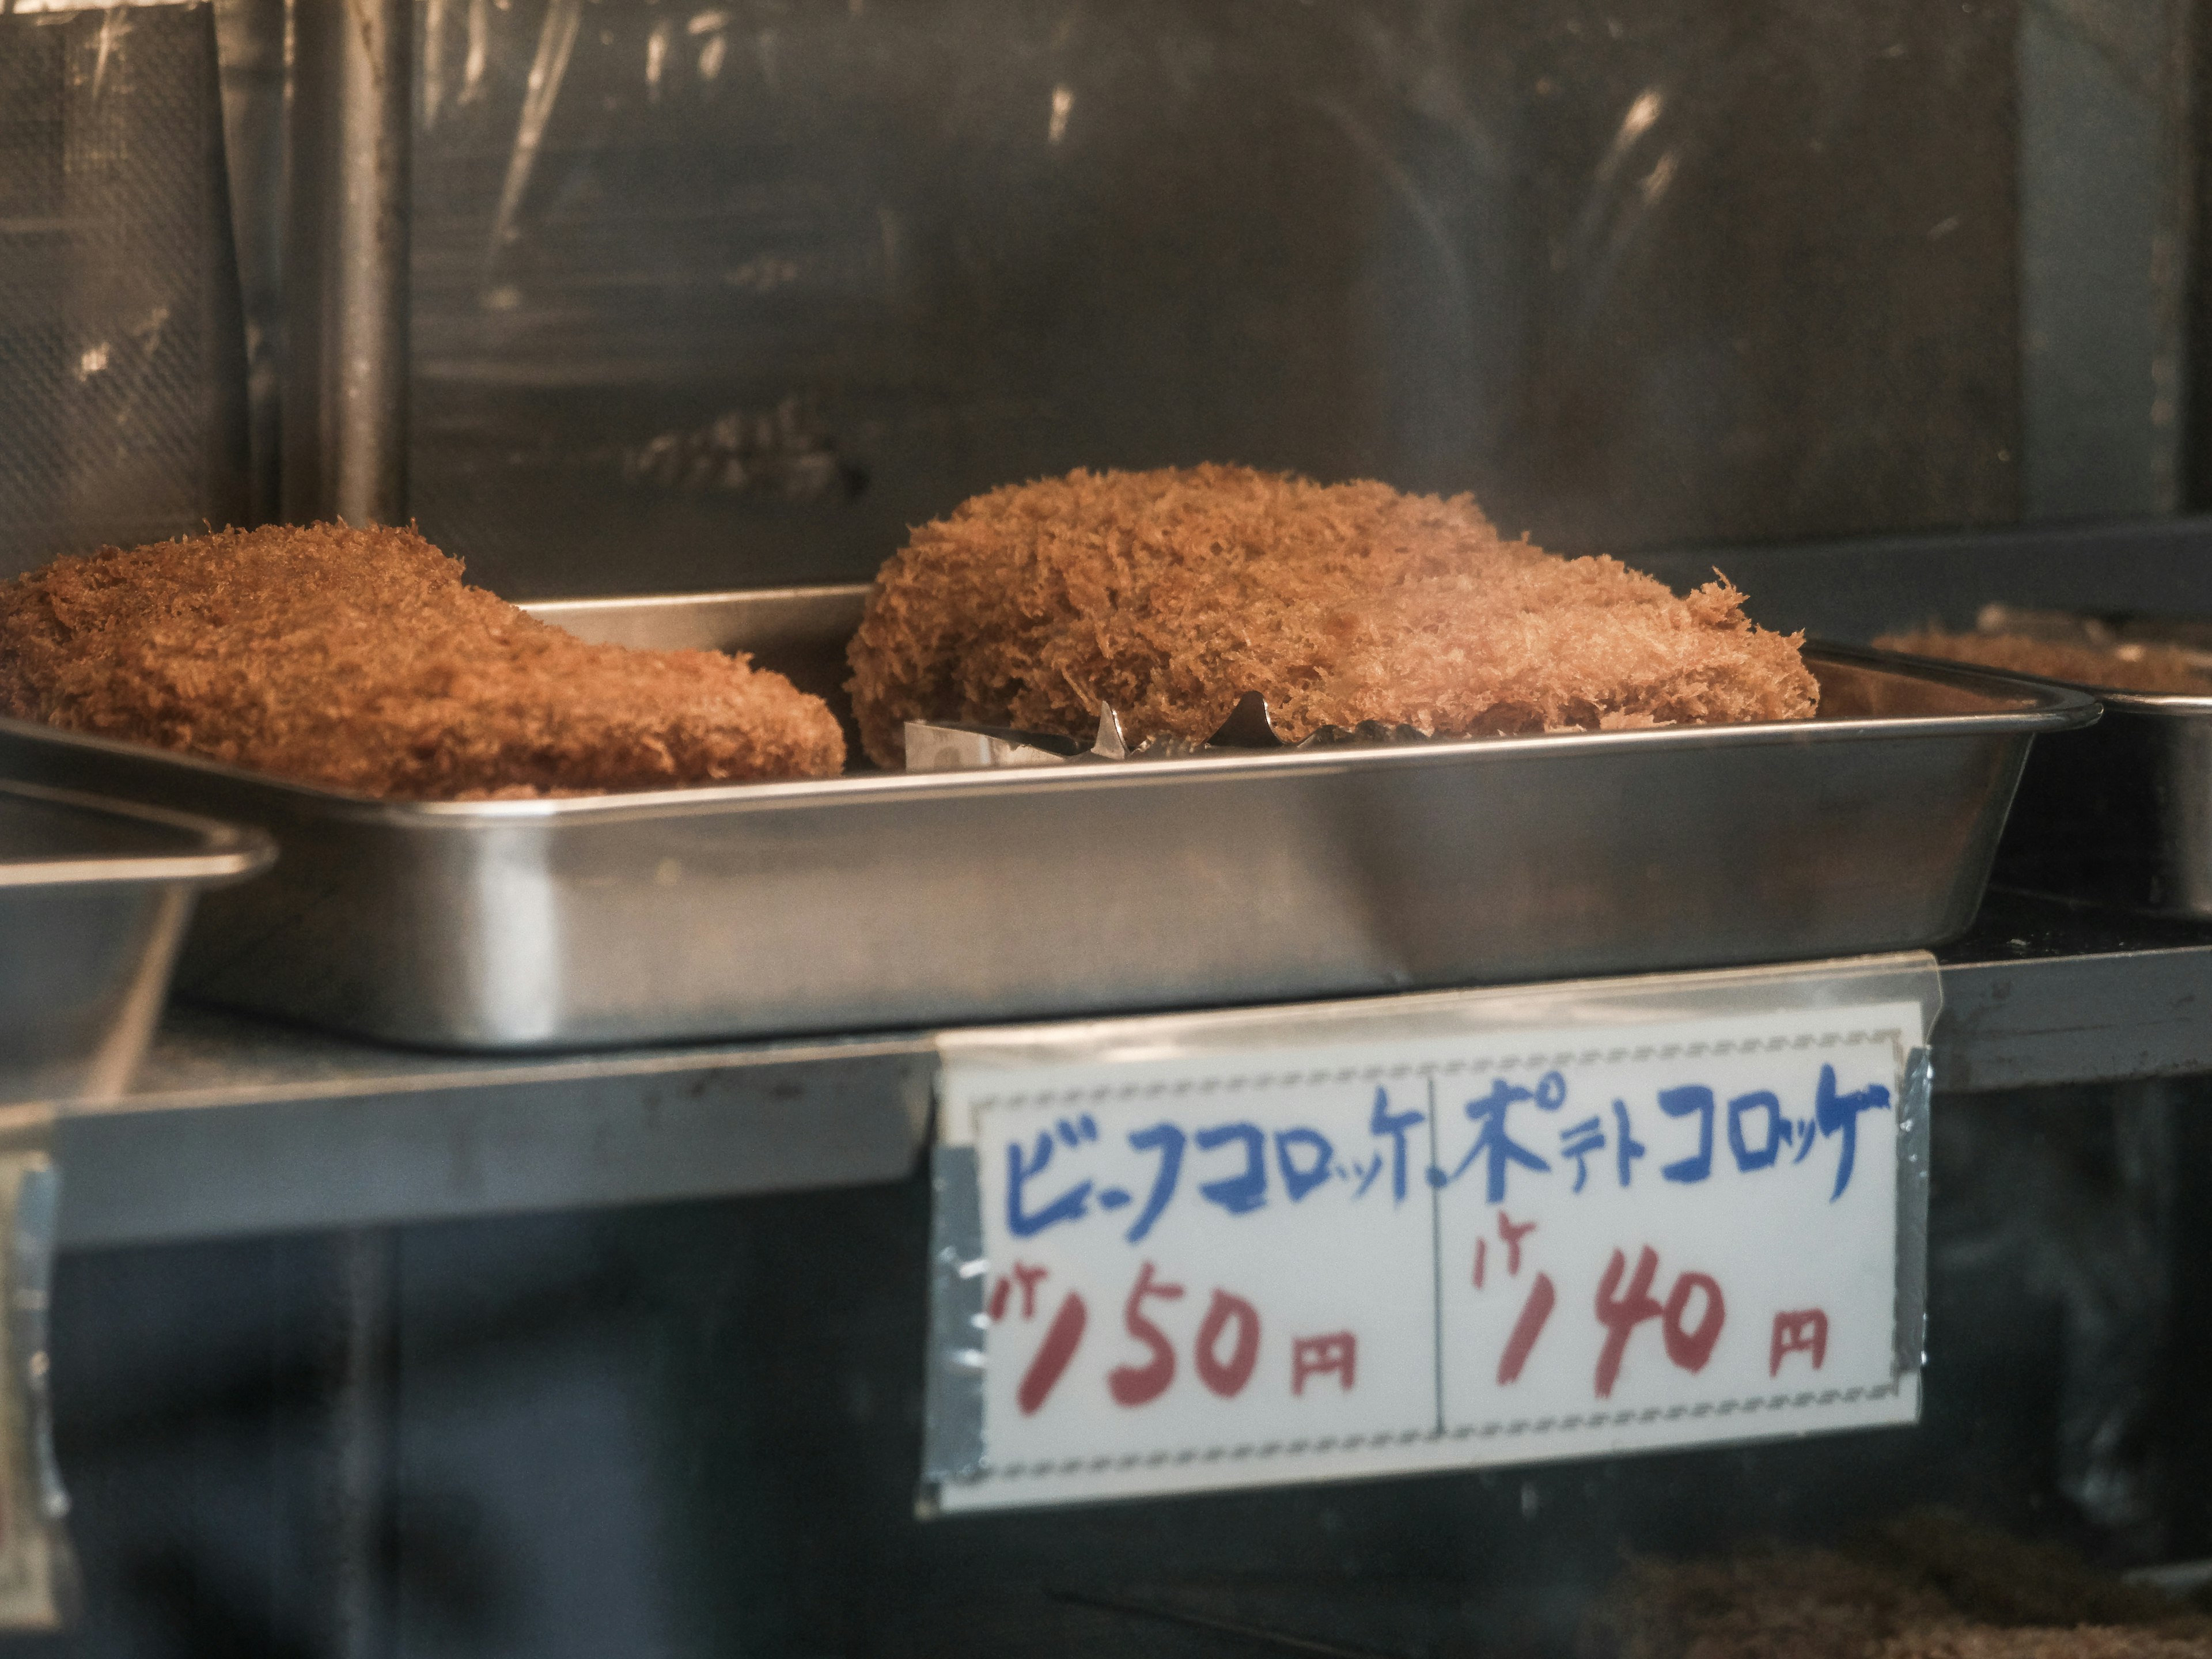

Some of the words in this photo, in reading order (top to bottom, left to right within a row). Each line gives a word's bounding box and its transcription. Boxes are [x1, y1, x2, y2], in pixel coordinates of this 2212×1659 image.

[1006, 1085, 1426, 1244] ビーフコロッケ
[1426, 1063, 1892, 1205] ポテトコロッケ
